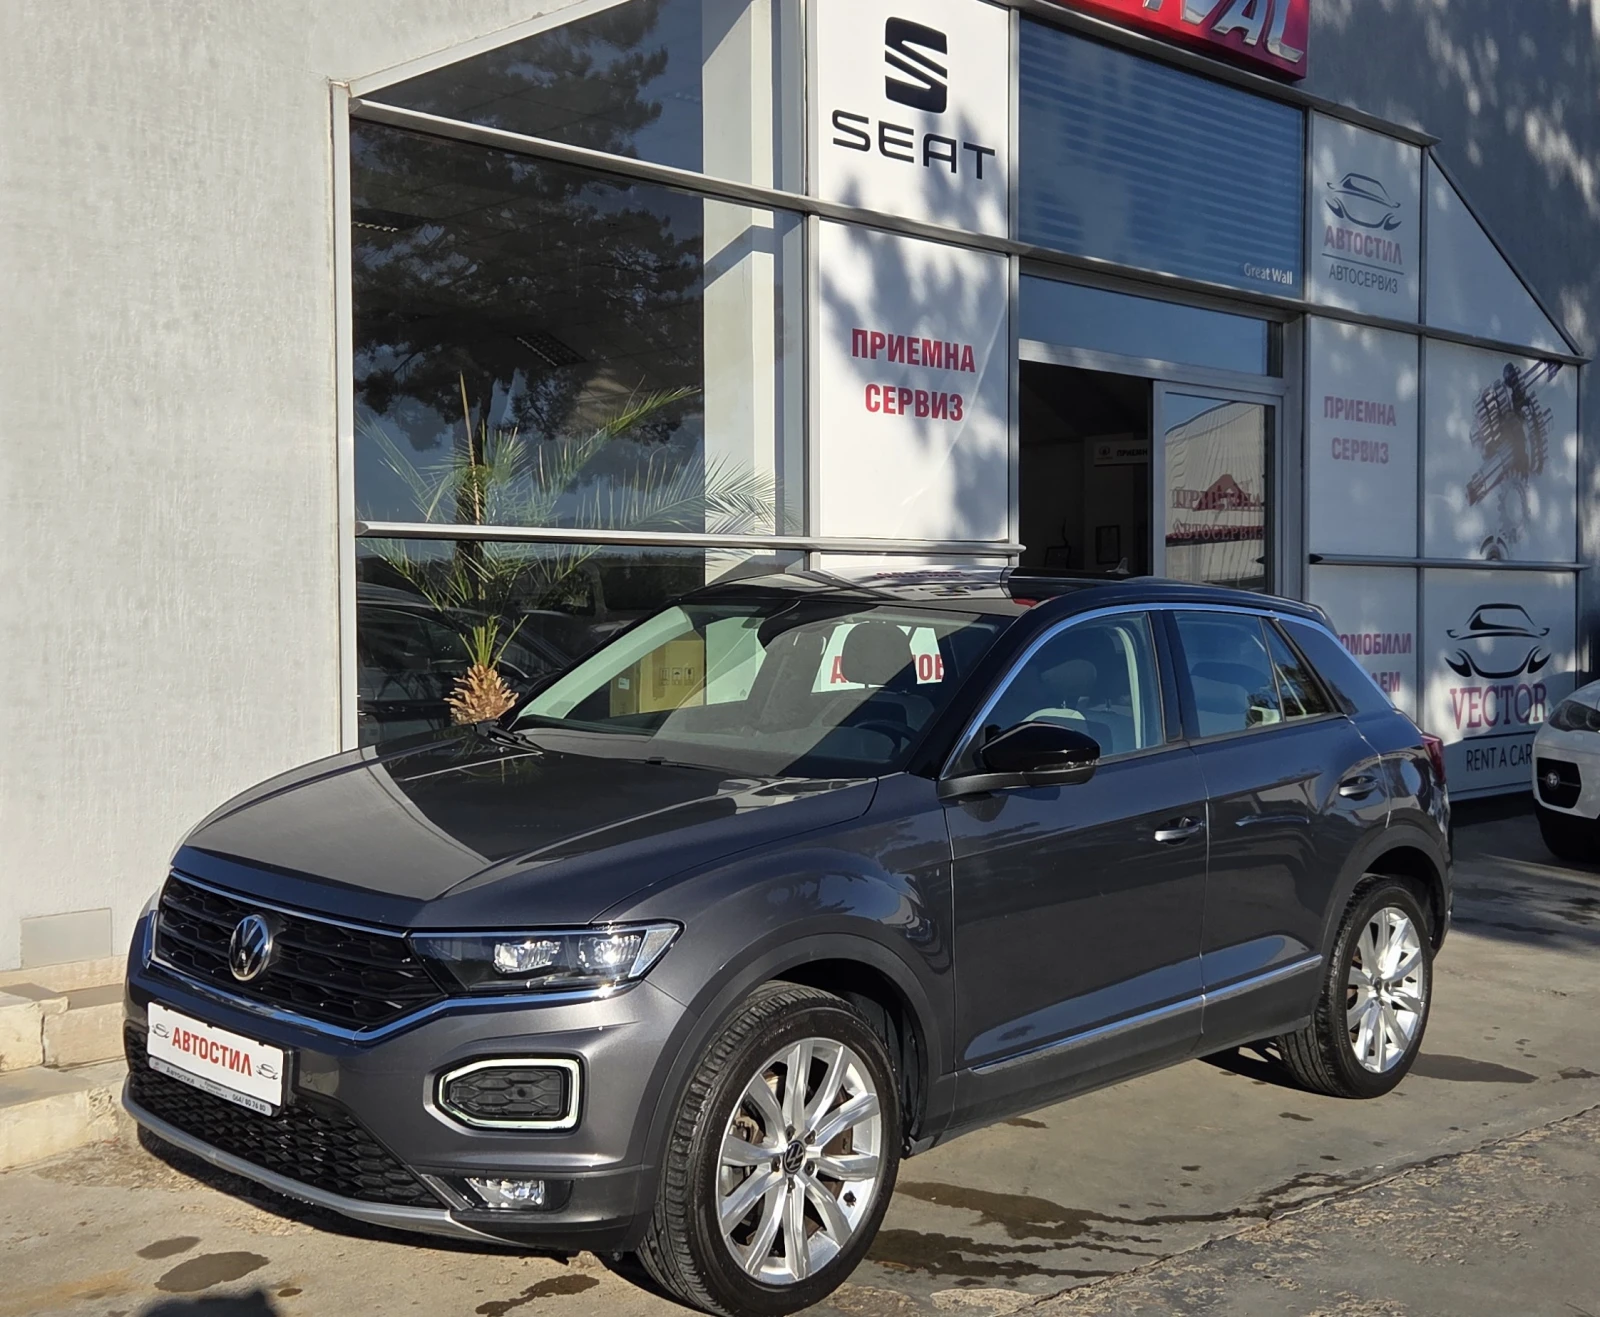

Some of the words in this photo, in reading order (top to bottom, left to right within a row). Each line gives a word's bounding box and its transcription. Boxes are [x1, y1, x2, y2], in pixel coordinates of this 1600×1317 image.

[832, 109, 996, 180] SEAT
[1323, 225, 1403, 266] АВТОСТИЛ
[1243, 262, 1271, 281] Great
[1272, 267, 1293, 285] Wall
[1329, 263, 1398, 294] АВТОСЕРВИЗ
[852, 328, 976, 373] ПРИЕМНА
[865, 383, 964, 421] СЕРВИЗ
[1324, 395, 1397, 427] ПРИЕМНА
[1331, 437, 1389, 464] СЕРВИЗ
[1338, 633, 1412, 655] ОМОБИЛИ
[1450, 683, 1548, 730] VECTOR
[1466, 747, 1497, 772] RENT
[1499, 747, 1507, 768] A
[1510, 744, 1533, 766] CAR
[172, 1027, 252, 1077] АВТОСТИЛ
